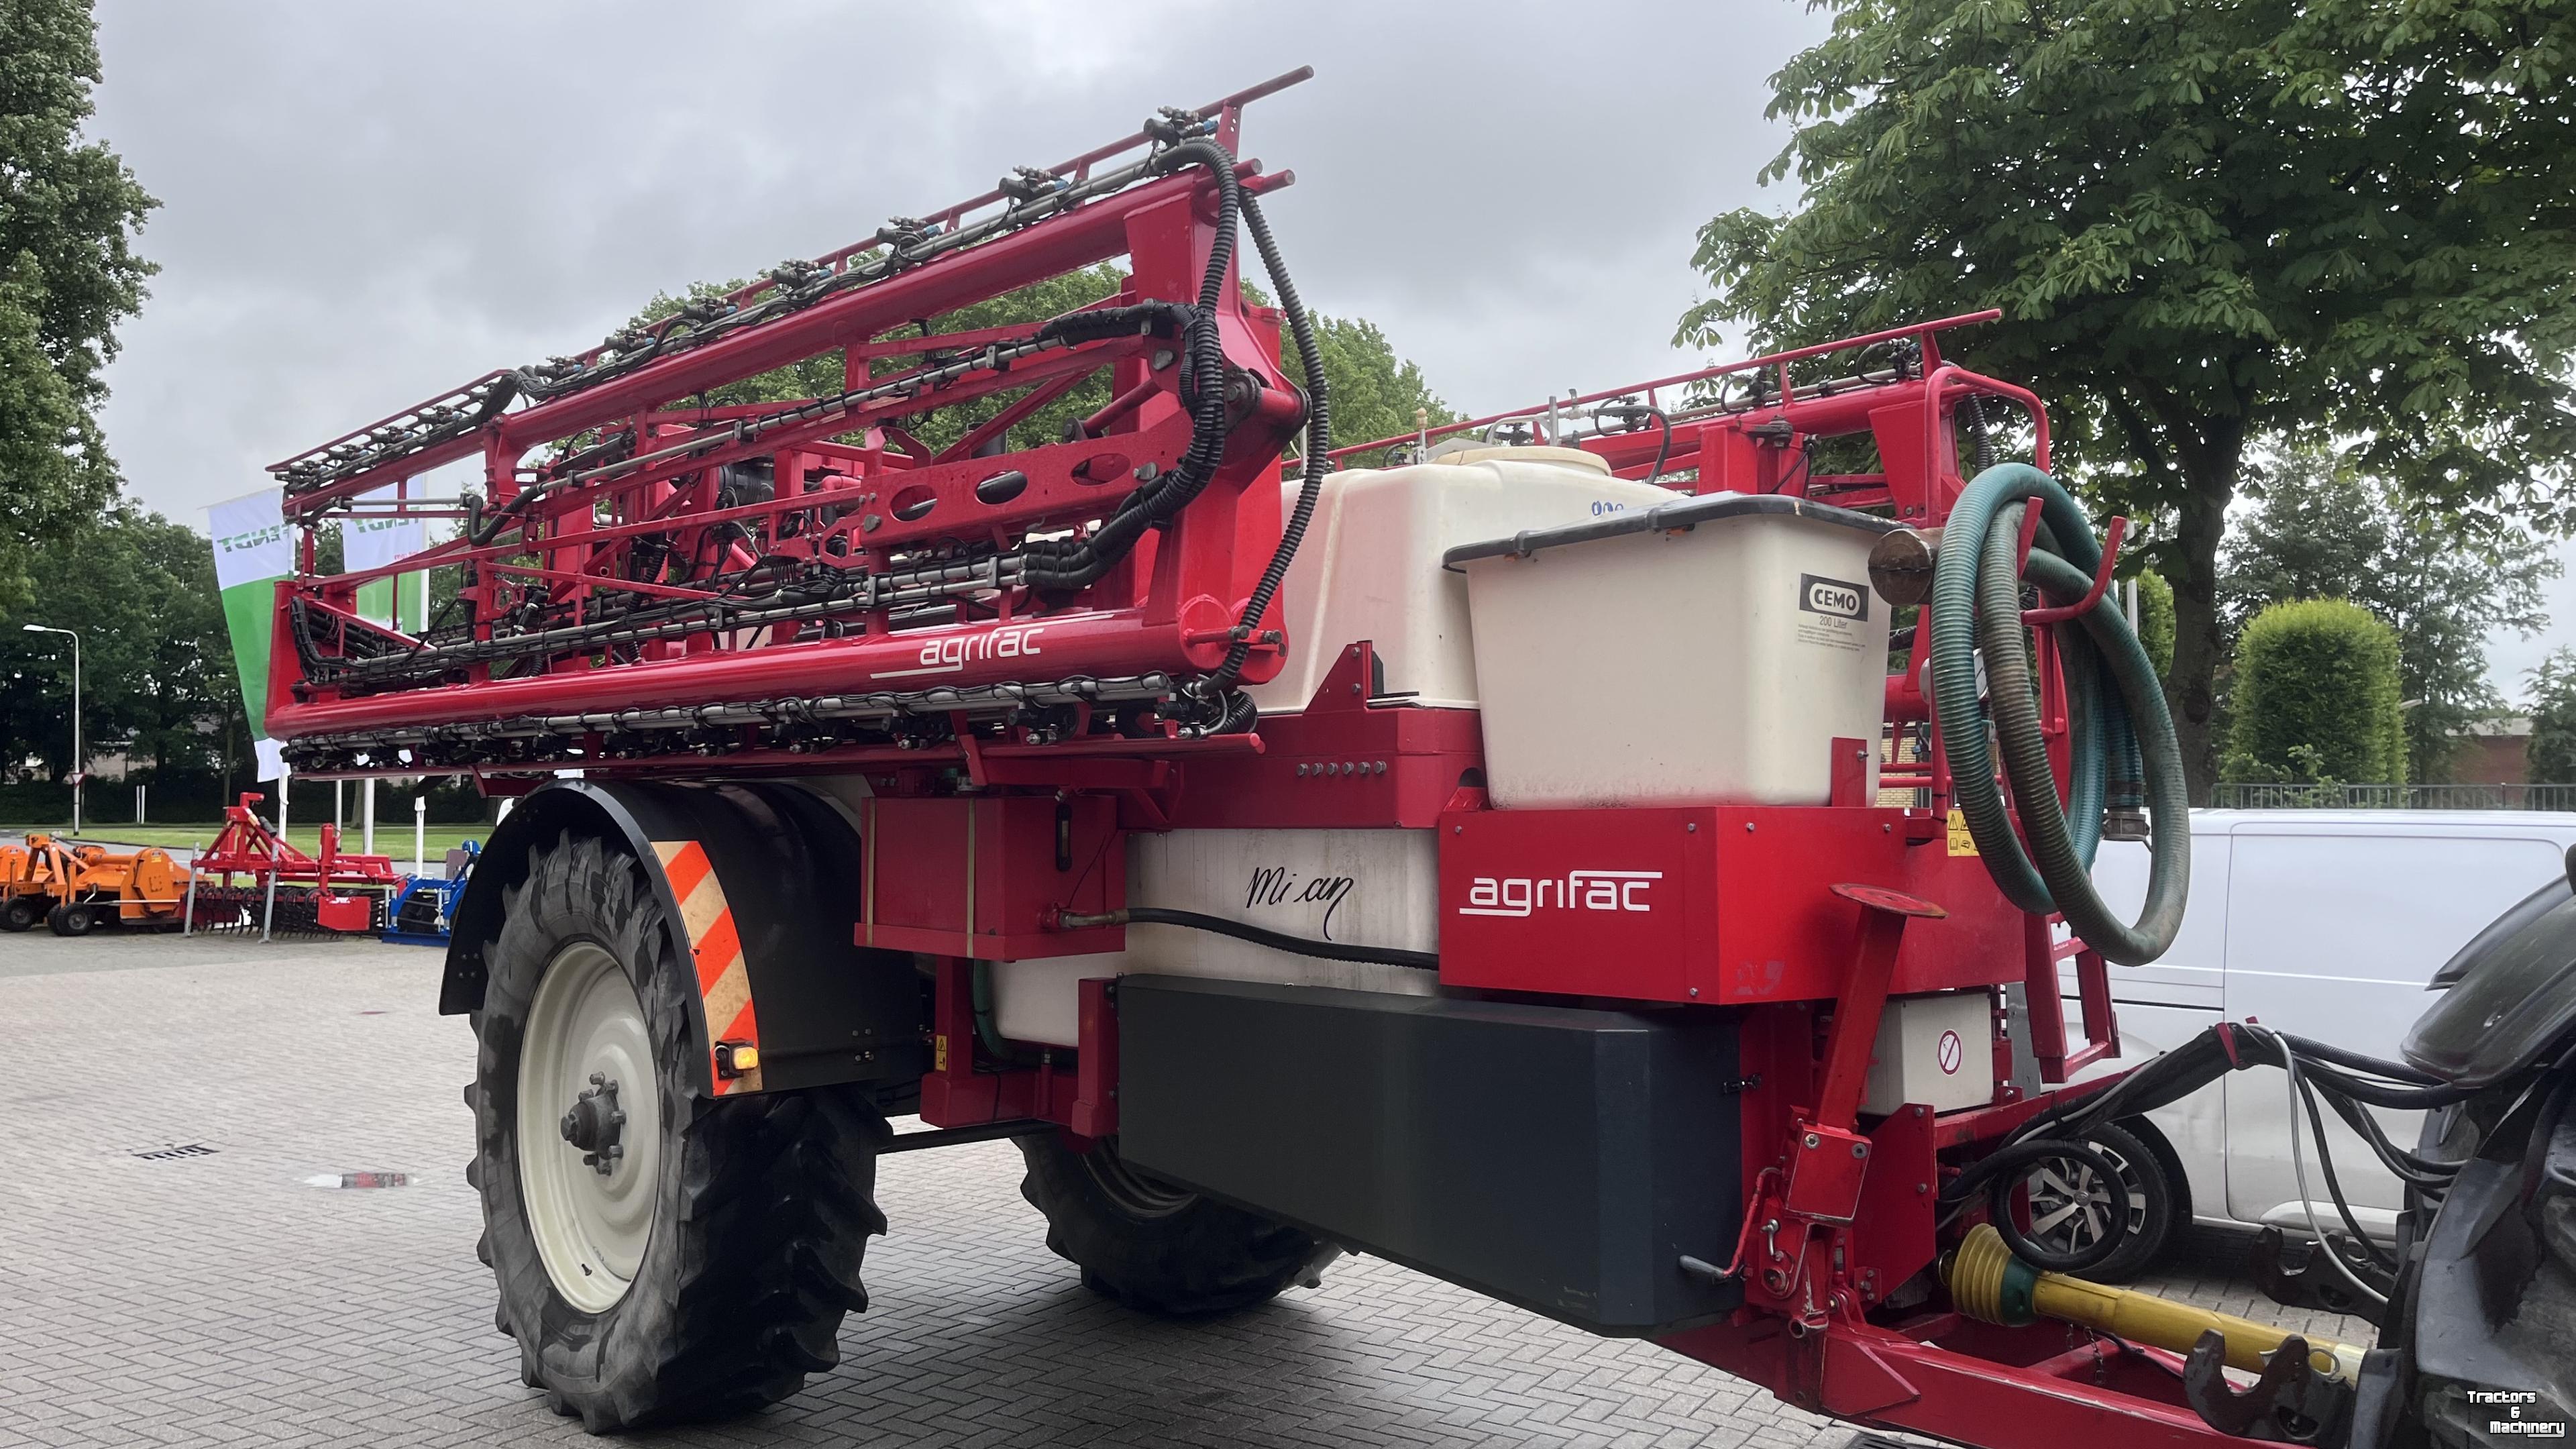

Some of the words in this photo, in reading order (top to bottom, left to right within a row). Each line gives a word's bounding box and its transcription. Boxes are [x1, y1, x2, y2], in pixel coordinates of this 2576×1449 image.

[1814, 588, 1857, 611] CEMO
[1819, 615, 1832, 627] 200
[1833, 619, 1847, 629] Liter
[869, 614, 1115, 680] agrifac
[1458, 870, 1664, 918] agrifac
